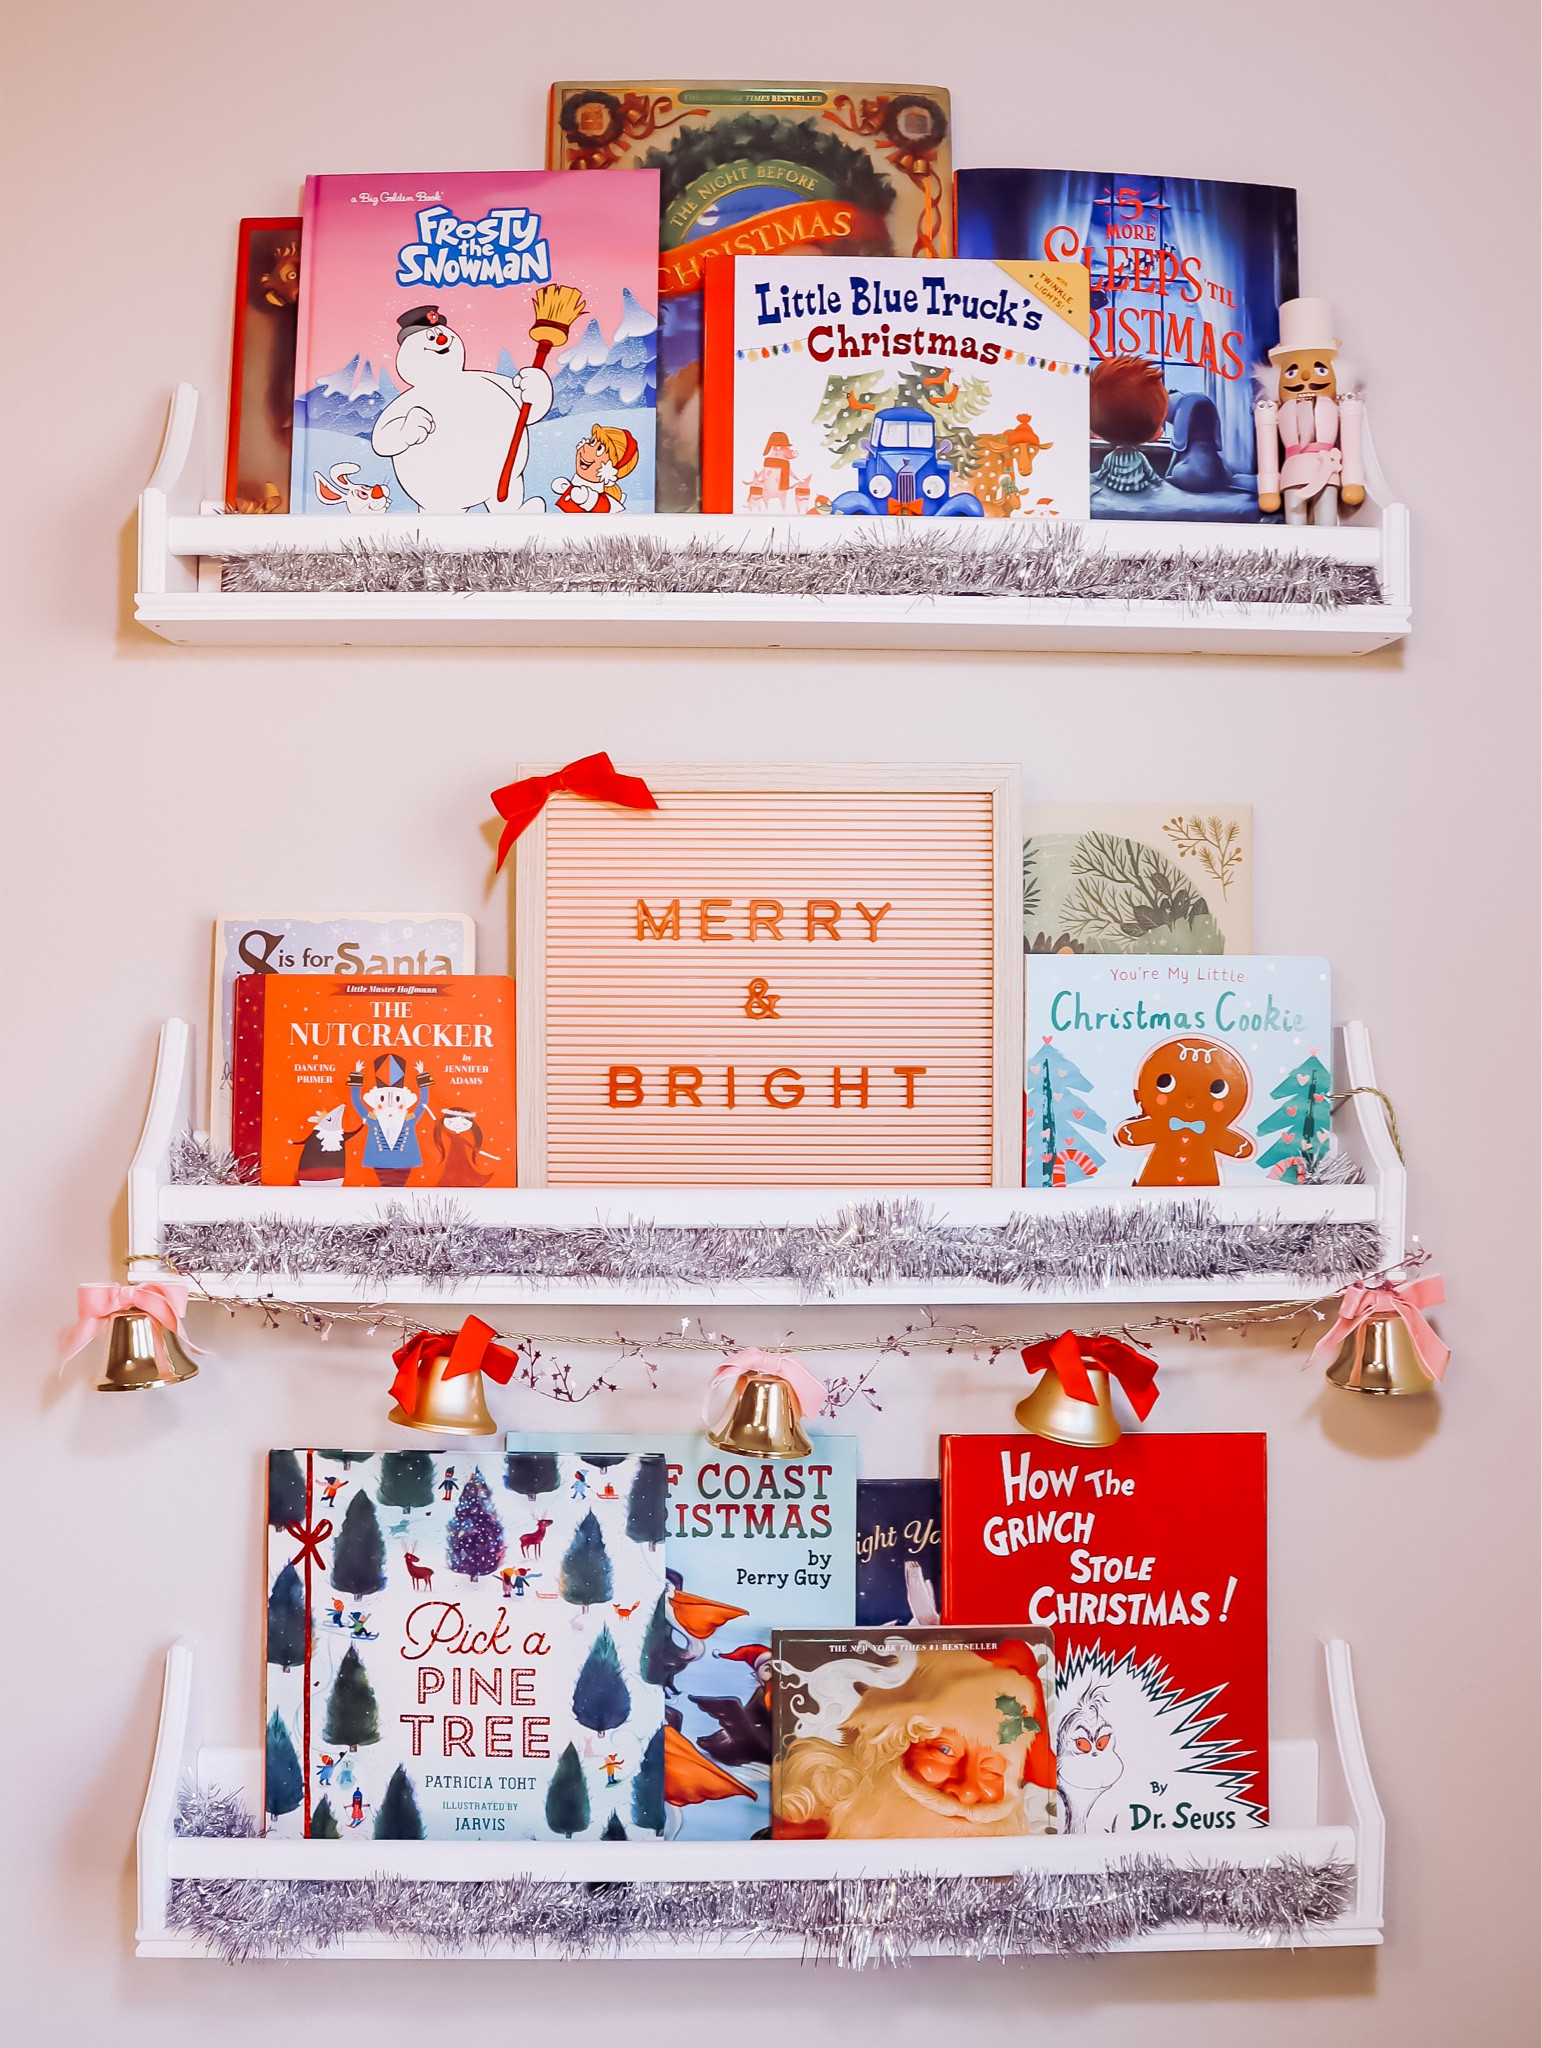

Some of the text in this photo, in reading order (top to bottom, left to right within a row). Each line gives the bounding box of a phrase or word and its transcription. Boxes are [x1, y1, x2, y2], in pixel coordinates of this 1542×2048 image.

[771, 94, 823, 102] BESTSELLER
[350, 191, 442, 206] a Big Golden Book
[670, 165, 818, 228] THE NIGHT BEFORE
[1117, 187, 1144, 220] 5
[1105, 223, 1157, 241] MORE
[458, 238, 495, 257] the
[1034, 281, 1065, 310] LIGHTS!
[1039, 272, 1074, 305] TWINKLE
[754, 276, 1043, 331] Little Blue Truck's
[807, 323, 1002, 365] Christmas
[636, 898, 892, 943] MERRY
[278, 949, 295, 968] is
[302, 947, 334, 968] for
[334, 942, 453, 976] Santa
[1110, 966, 1246, 984] You're My Little
[346, 984, 438, 996] Little Master Hoffmann
[744, 976, 782, 1020] &
[369, 1001, 413, 1019] THE
[1050, 990, 1308, 1033] Christmas Cookie
[288, 1022, 495, 1048] NUTCRACKER
[293, 1063, 336, 1073] DANCING
[443, 1064, 489, 1074] JENNIFER
[462, 1053, 473, 1064] by
[296, 1075, 333, 1084] PRIMER
[449, 1075, 484, 1086] ADAMS
[608, 1064, 928, 1110] BRIGHT
[697, 1462, 833, 1500] COAST
[1084, 1468, 1136, 1499] The
[665, 1503, 833, 1539] ISTMAS
[983, 1510, 1096, 1556] GRINCH
[807, 1549, 833, 1571] by
[1069, 1548, 1157, 1584] STOLE
[736, 1568, 832, 1590] Perry Guy
[400, 1600, 552, 1661] Pick a
[828, 1644, 847, 1653] THE
[872, 1644, 897, 1652] YORK
[899, 1644, 926, 1652] TIMES
[942, 1642, 998, 1651] BESTSELLER
[417, 1667, 537, 1707] PINE
[399, 1714, 552, 1759] TREE
[424, 1775, 537, 1791] PATRICIA TOHT
[441, 1801, 519, 1812] ILLUSTRATED BY
[1129, 1802, 1237, 1830] Dr. Seuss
[454, 1817, 506, 1832] JARVIS
